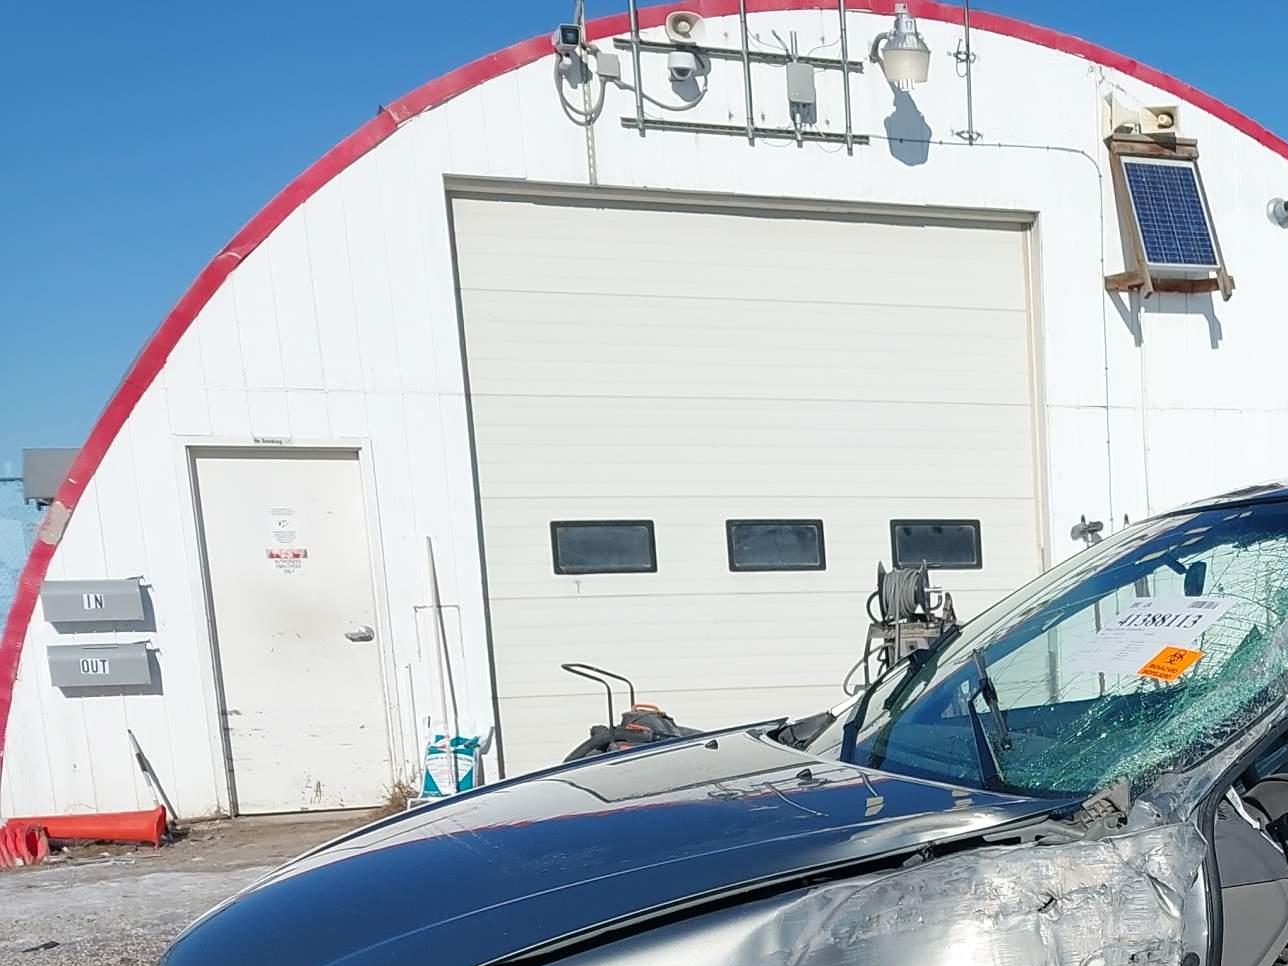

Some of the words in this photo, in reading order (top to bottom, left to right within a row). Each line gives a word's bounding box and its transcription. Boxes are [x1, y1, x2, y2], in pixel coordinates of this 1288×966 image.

[87, 594, 103, 609] IN
[1119, 613, 1203, 629] 41388113
[81, 659, 107, 673] OUT
